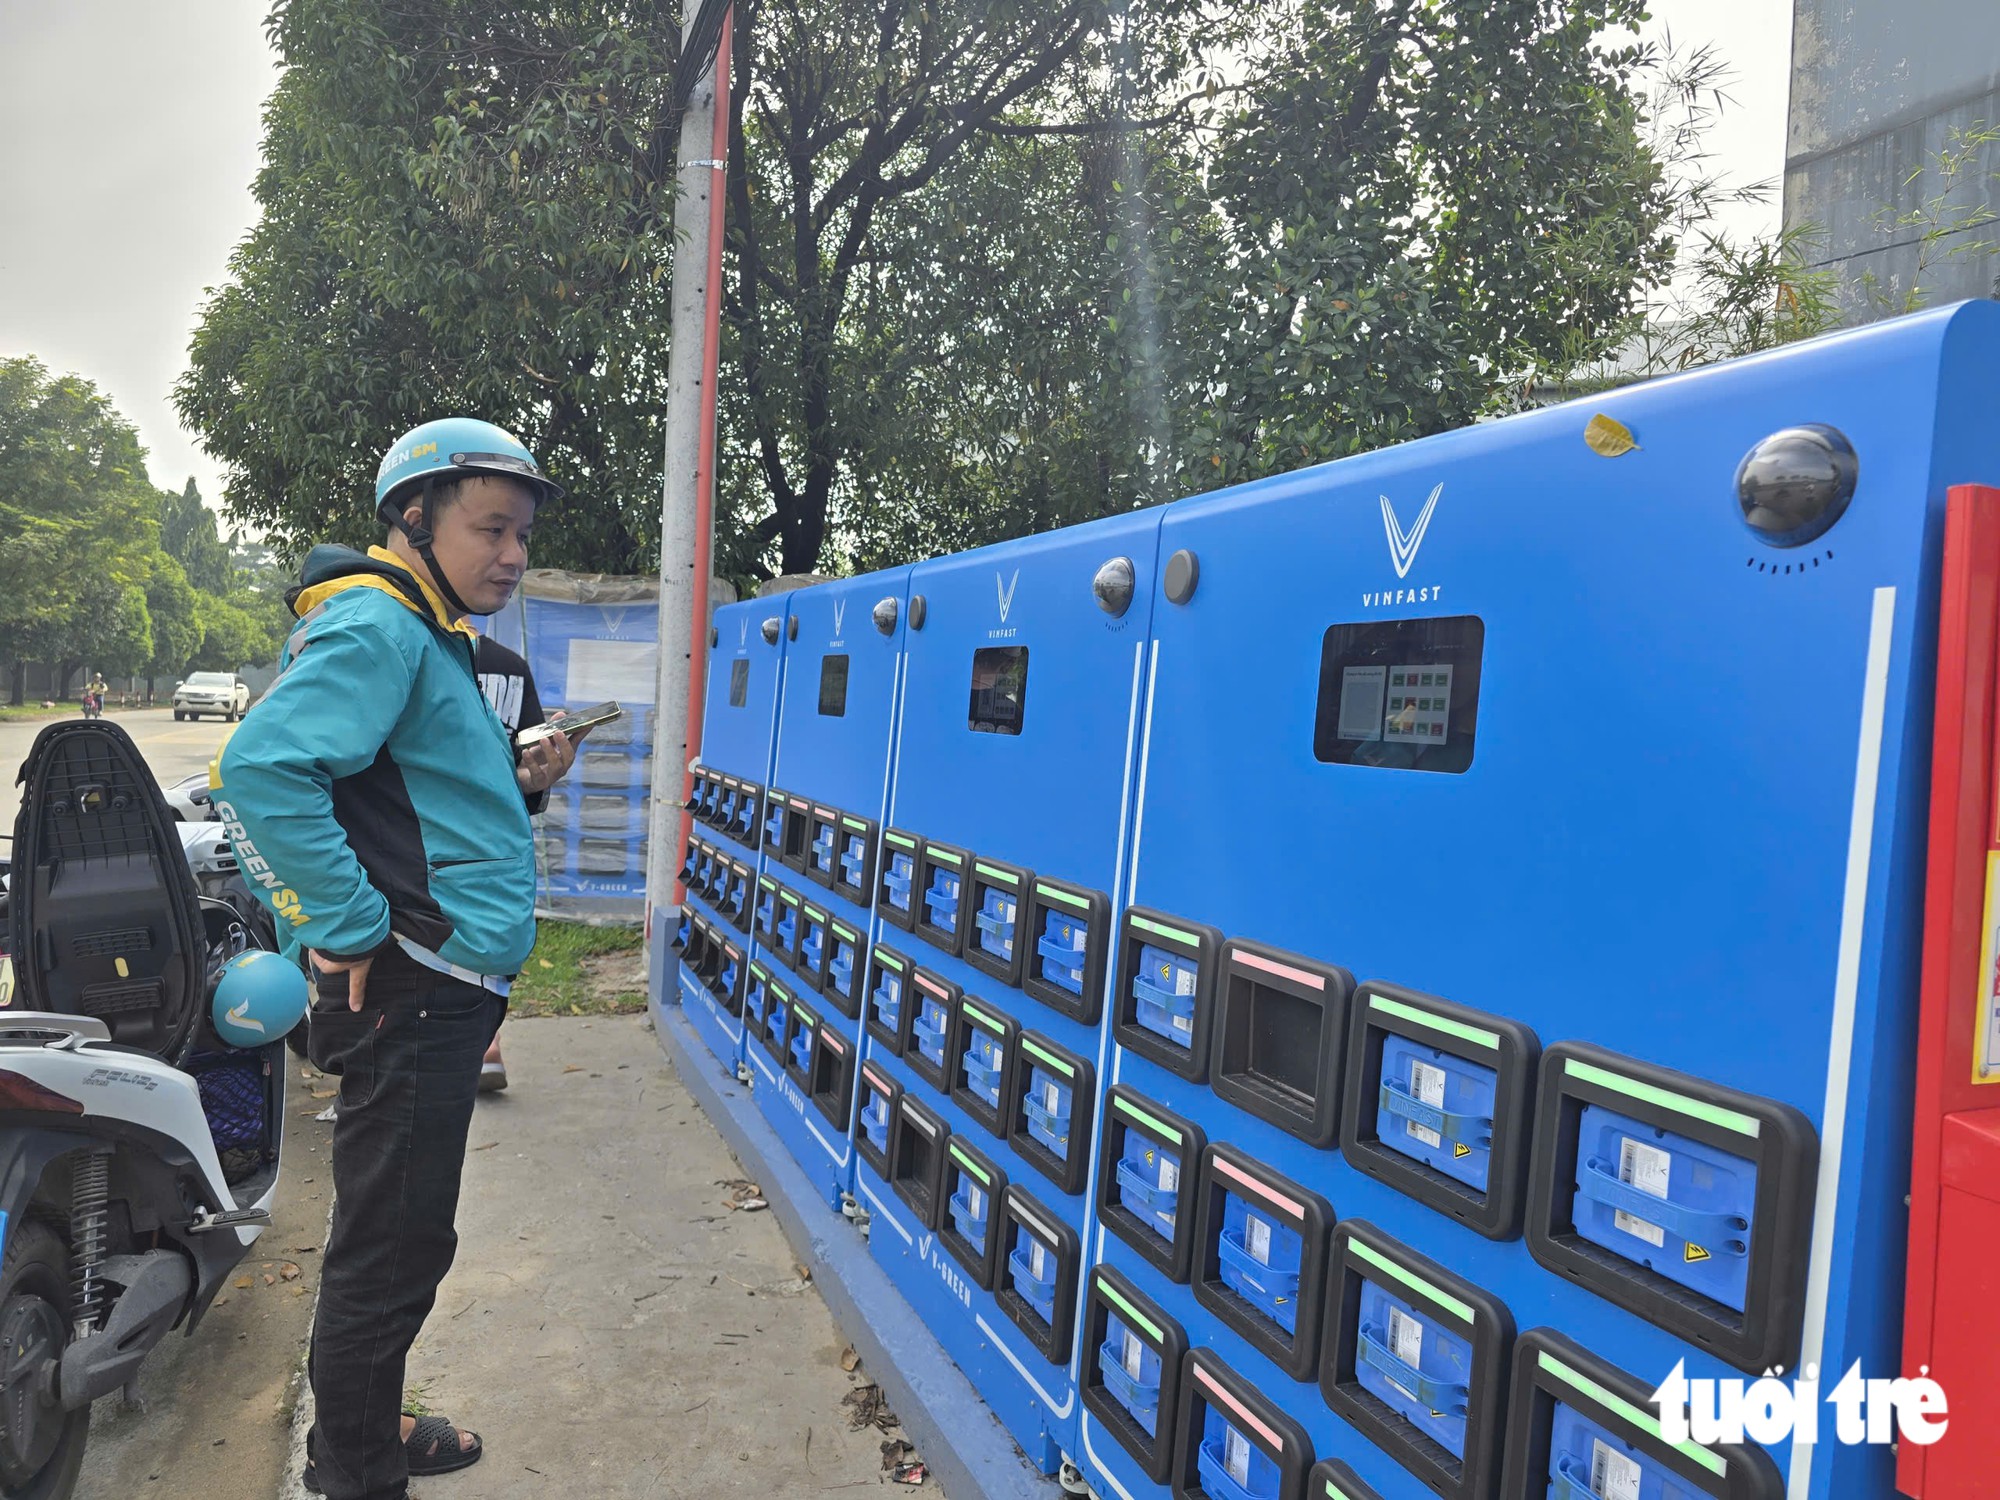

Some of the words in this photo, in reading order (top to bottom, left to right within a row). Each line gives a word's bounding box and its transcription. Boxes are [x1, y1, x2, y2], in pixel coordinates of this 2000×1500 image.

[379, 449, 410, 480] REEN
[411, 441, 437, 459] SM
[1362, 586, 1441, 607] VINFAST
[988, 628, 1017, 639] VINFAST
[216, 800, 286, 889] GREEN
[271, 888, 312, 927] SM
[932, 1249, 971, 1309] V-GREEN
